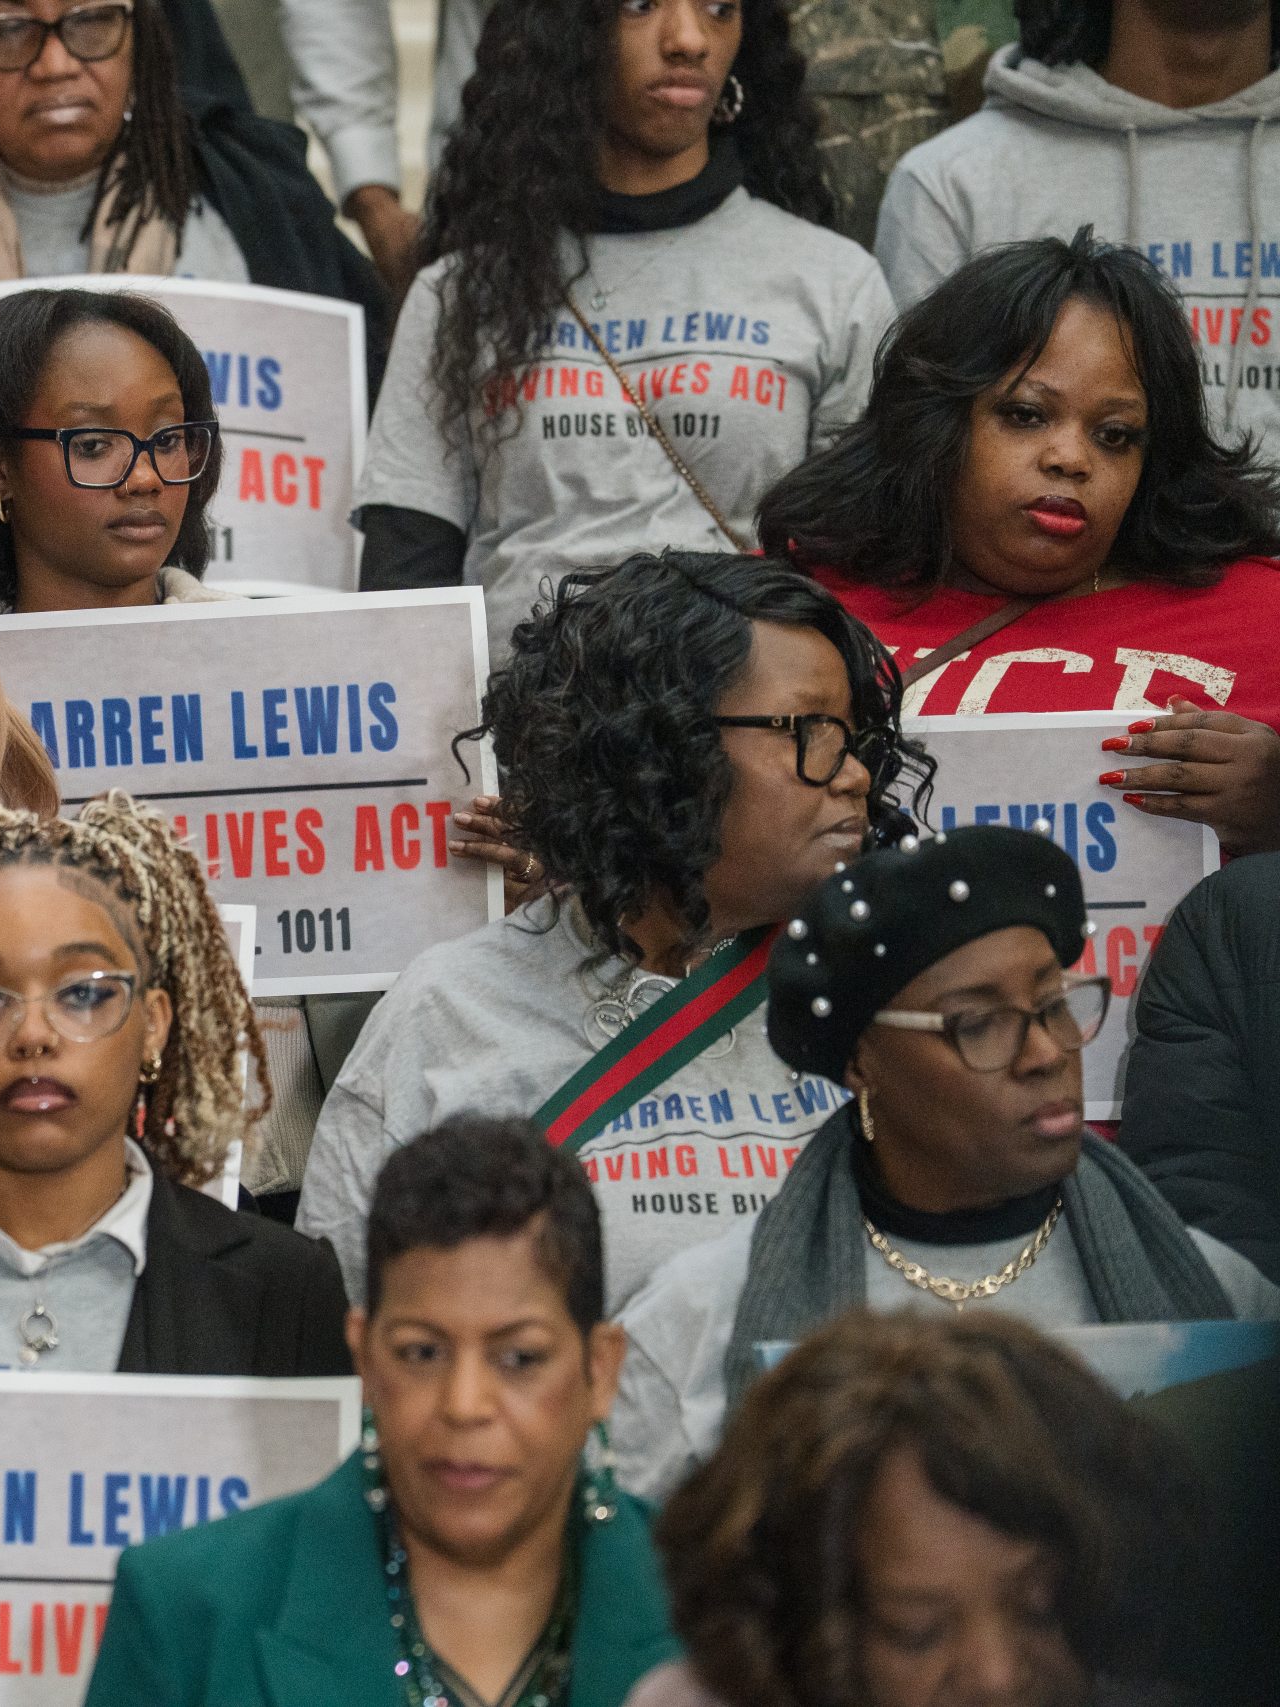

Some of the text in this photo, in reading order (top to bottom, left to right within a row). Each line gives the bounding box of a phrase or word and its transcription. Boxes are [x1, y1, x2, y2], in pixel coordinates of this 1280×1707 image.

[1211, 241, 1280, 279] LEW
[661, 311, 770, 346] LEWIS
[1191, 306, 1272, 347] IVES
[206, 351, 282, 411] WIS
[729, 364, 788, 412] ACT
[542, 413, 616, 439] HOUSE
[673, 413, 721, 438] 1011
[238, 448, 327, 510] ACT
[31, 681, 399, 769] ARREN LEWIS
[174, 801, 452, 880] IVES ACT
[277, 907, 351, 954] 1011
[598, 1088, 734, 1138] ARREN
[582, 1144, 699, 1184] AVING
[632, 1193, 719, 1215] HOUSE
